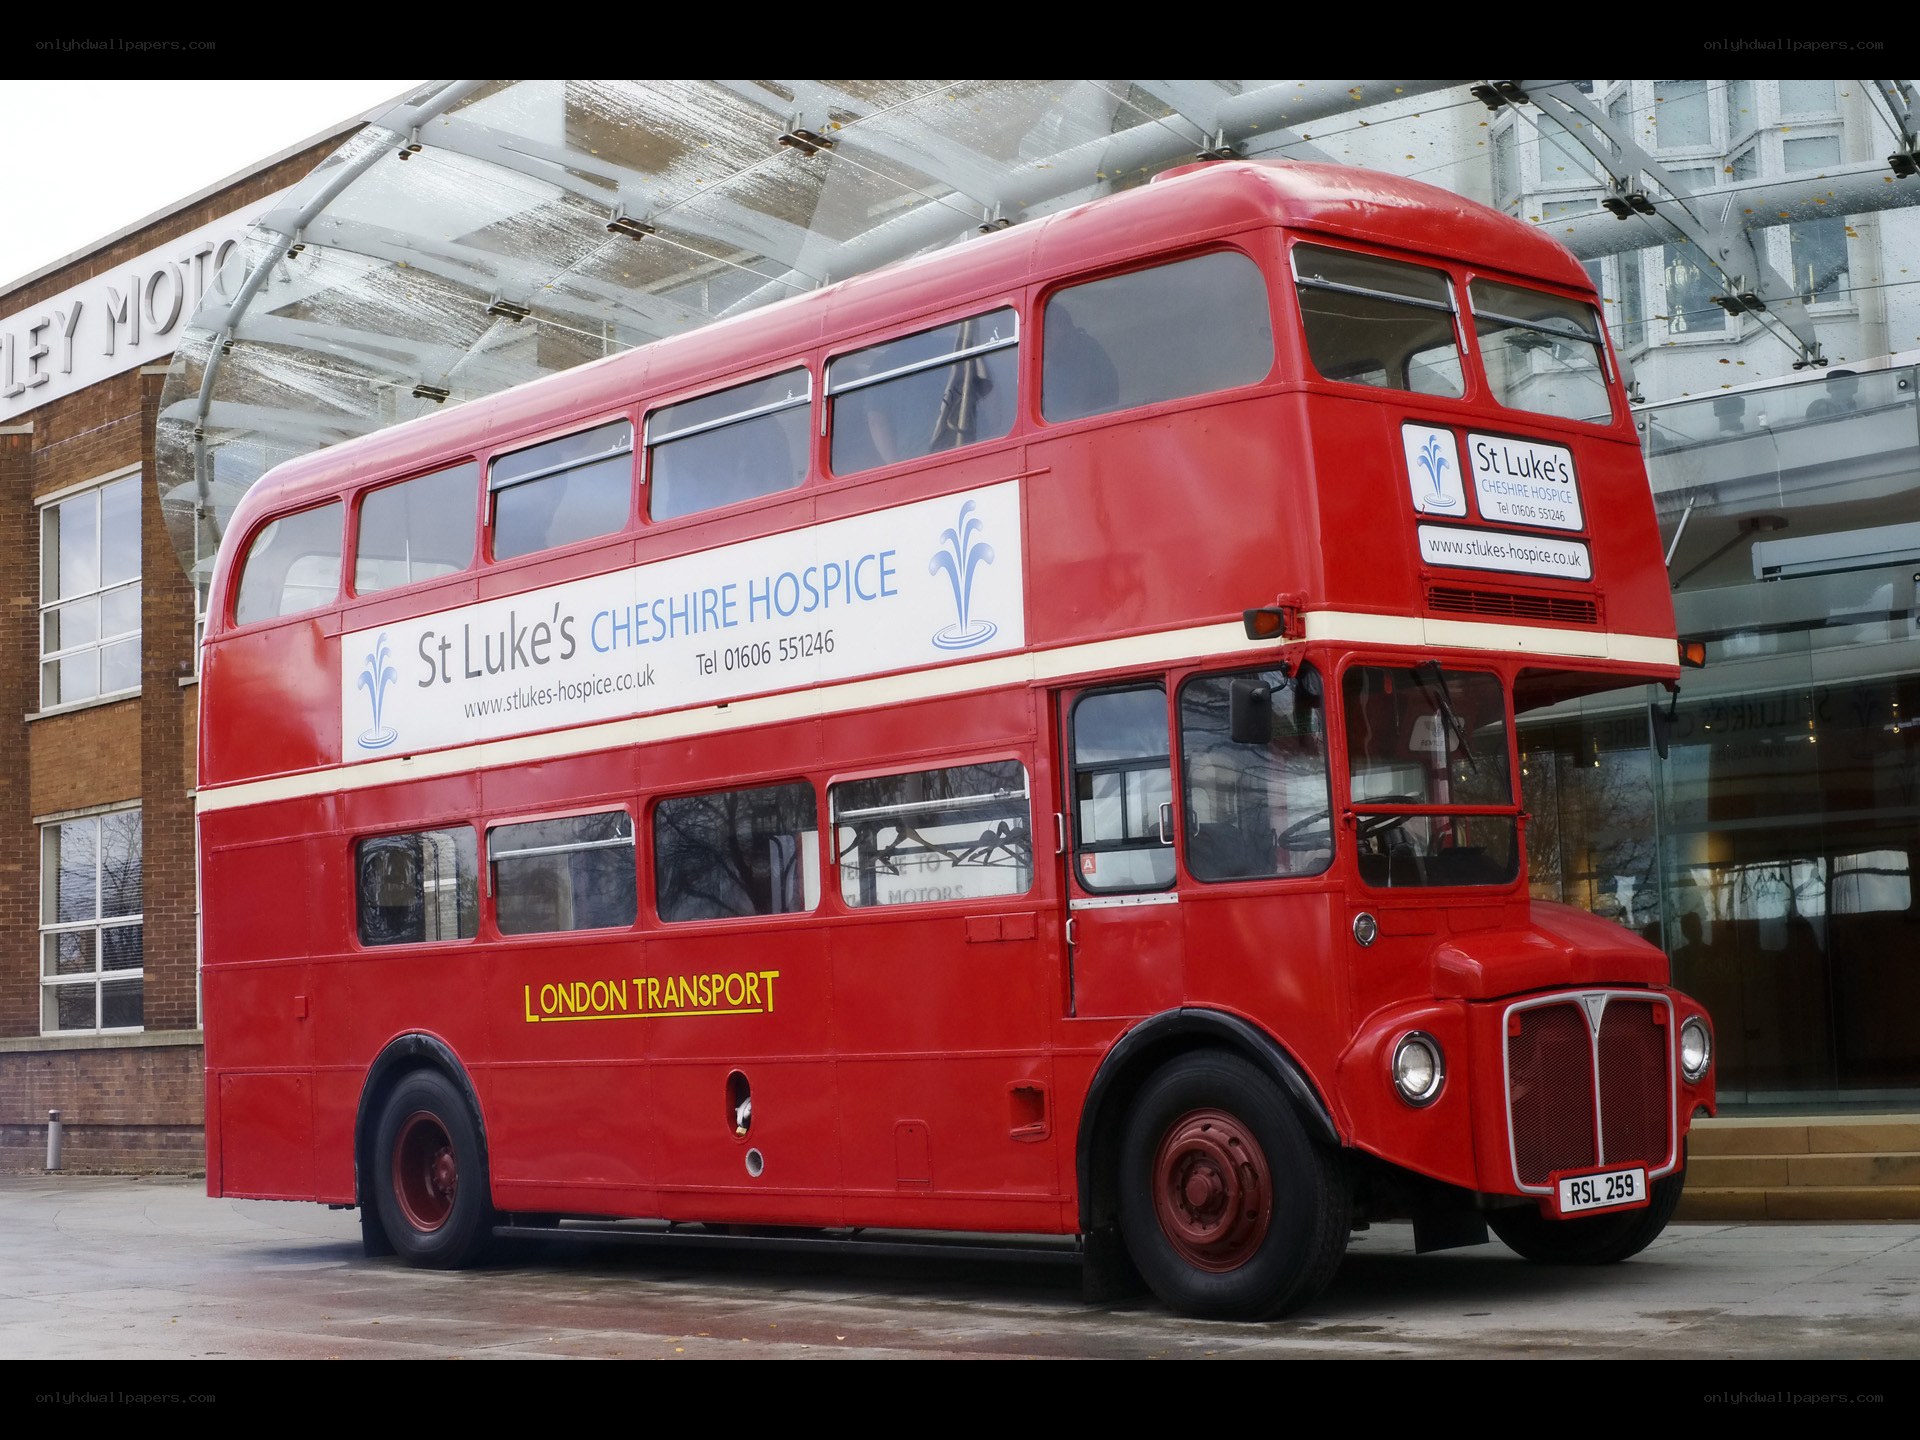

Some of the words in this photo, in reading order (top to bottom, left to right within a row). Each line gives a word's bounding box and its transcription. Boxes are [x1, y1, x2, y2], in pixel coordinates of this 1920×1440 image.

[0, 300, 83, 398] LEY
[1477, 442, 1500, 474] St
[1504, 446, 1569, 484] Luke's
[1481, 478, 1530, 498] CHESHIRE
[1531, 486, 1573, 504] HOSPICE
[1496, 501, 1510, 515] Tel
[1511, 504, 1536, 518] 01606
[1538, 508, 1566, 522] 551246
[1429, 539, 1582, 567] www.stlukes-hospice.co.uk
[418, 631, 452, 688] St
[464, 602, 576, 679] Luke's
[591, 583, 739, 653] CHESHIRE
[749, 550, 898, 623] HOSPICE
[696, 650, 718, 676] Tel
[724, 641, 771, 671] 01606
[779, 629, 835, 662] 551246
[464, 663, 655, 719] www.stlukes-hospice.co.uk
[525, 980, 627, 1022] LONDON
[632, 970, 780, 1012] TRANSPORT
[1571, 1180, 1601, 1205] RSL
[1606, 1174, 1634, 1199] 259
